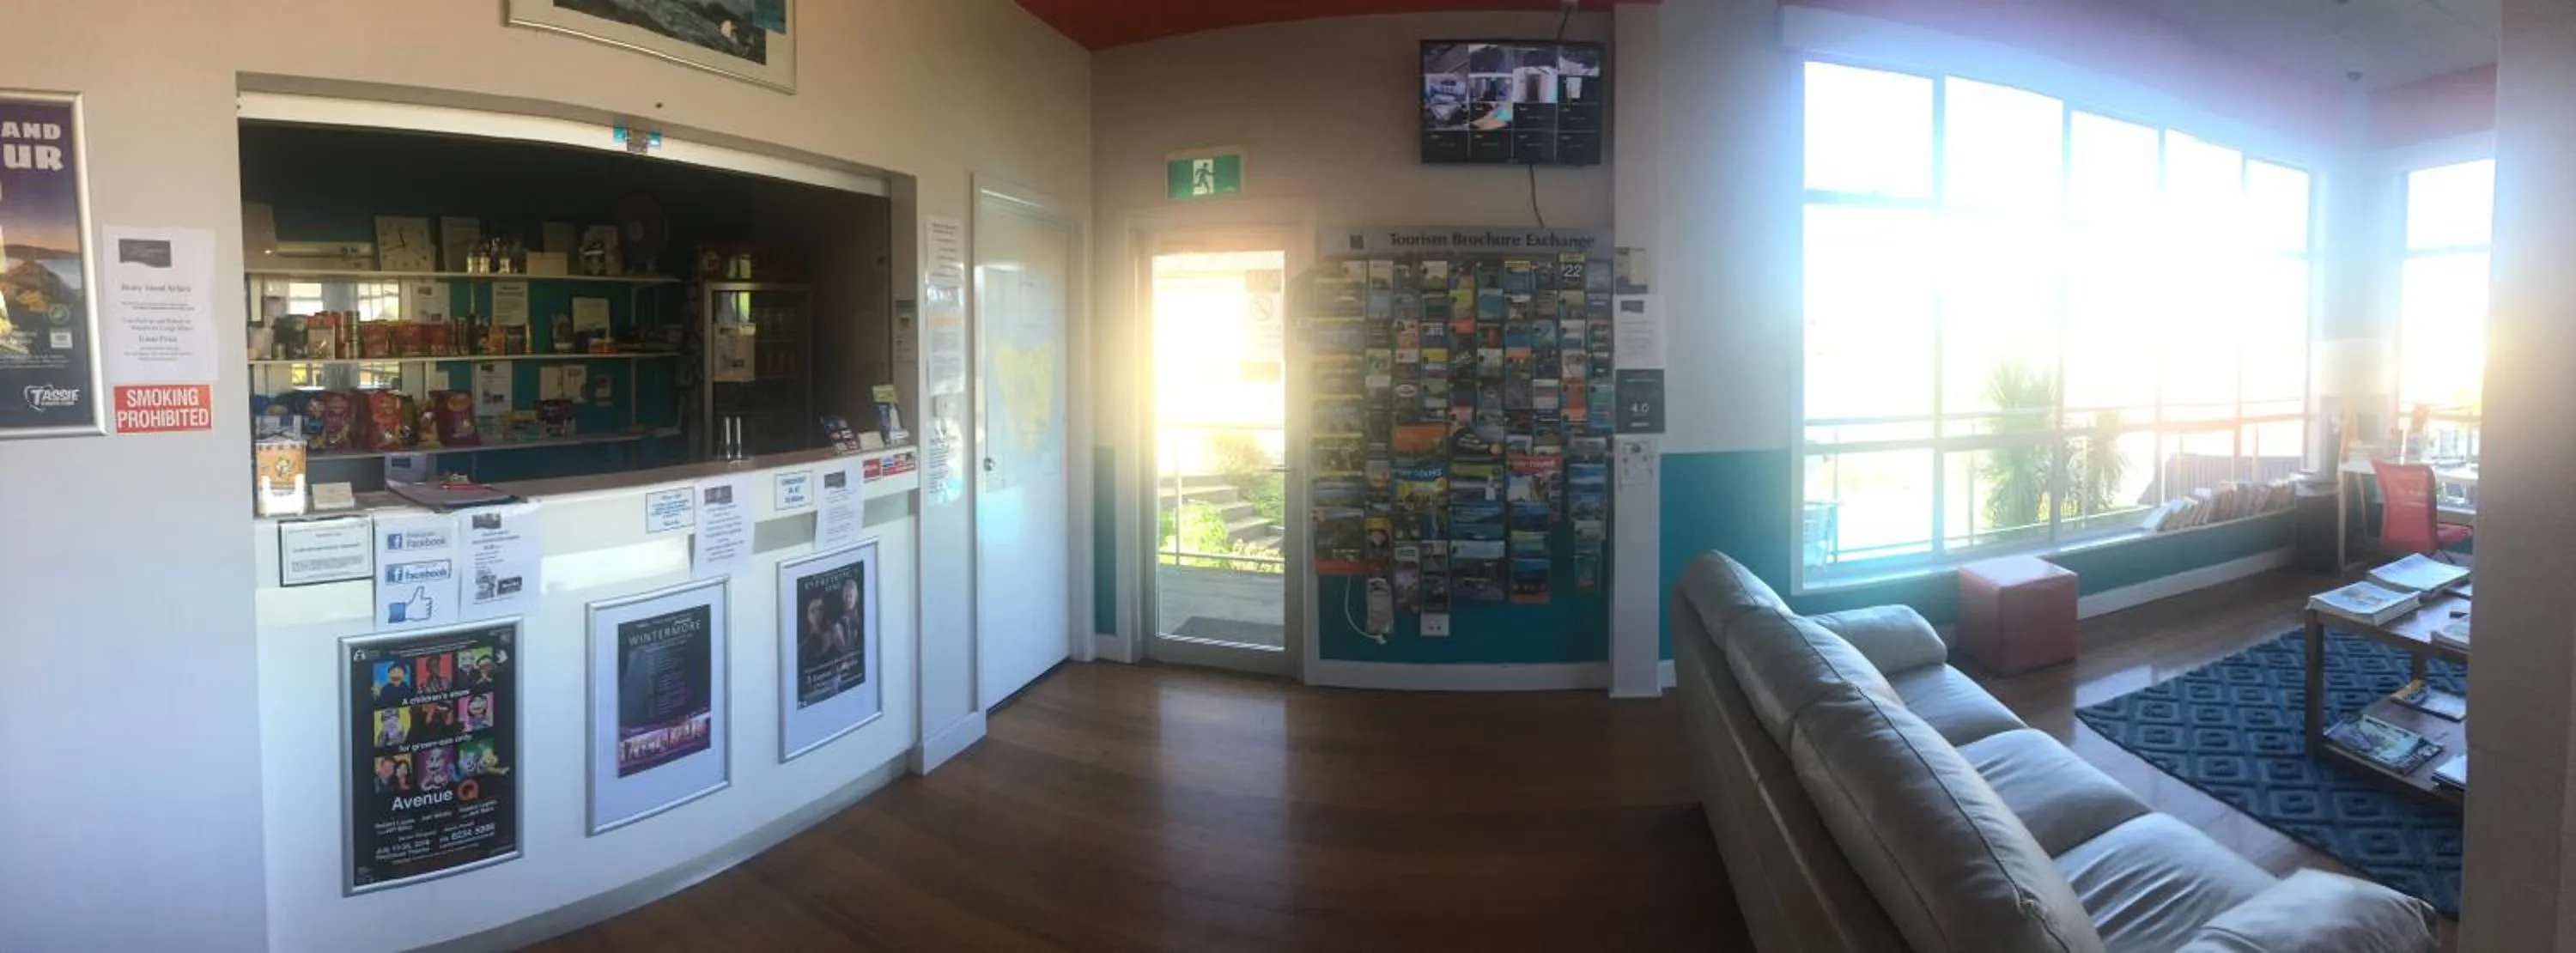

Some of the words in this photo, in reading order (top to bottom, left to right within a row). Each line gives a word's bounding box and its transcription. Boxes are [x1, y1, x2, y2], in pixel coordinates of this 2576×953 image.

[2, 122, 61, 140] AND
[3, 143, 64, 172] UR
[1388, 232, 1447, 246] Tourism
[1453, 231, 1521, 246] Brochure
[1527, 231, 1595, 249] Exchange
[31, 389, 80, 405] TASSIE
[126, 387, 198, 408] SMOKING
[118, 408, 209, 428] PROHIBITED
[627, 619, 702, 646] WINTERMORE
[392, 789, 454, 810] Avenue
